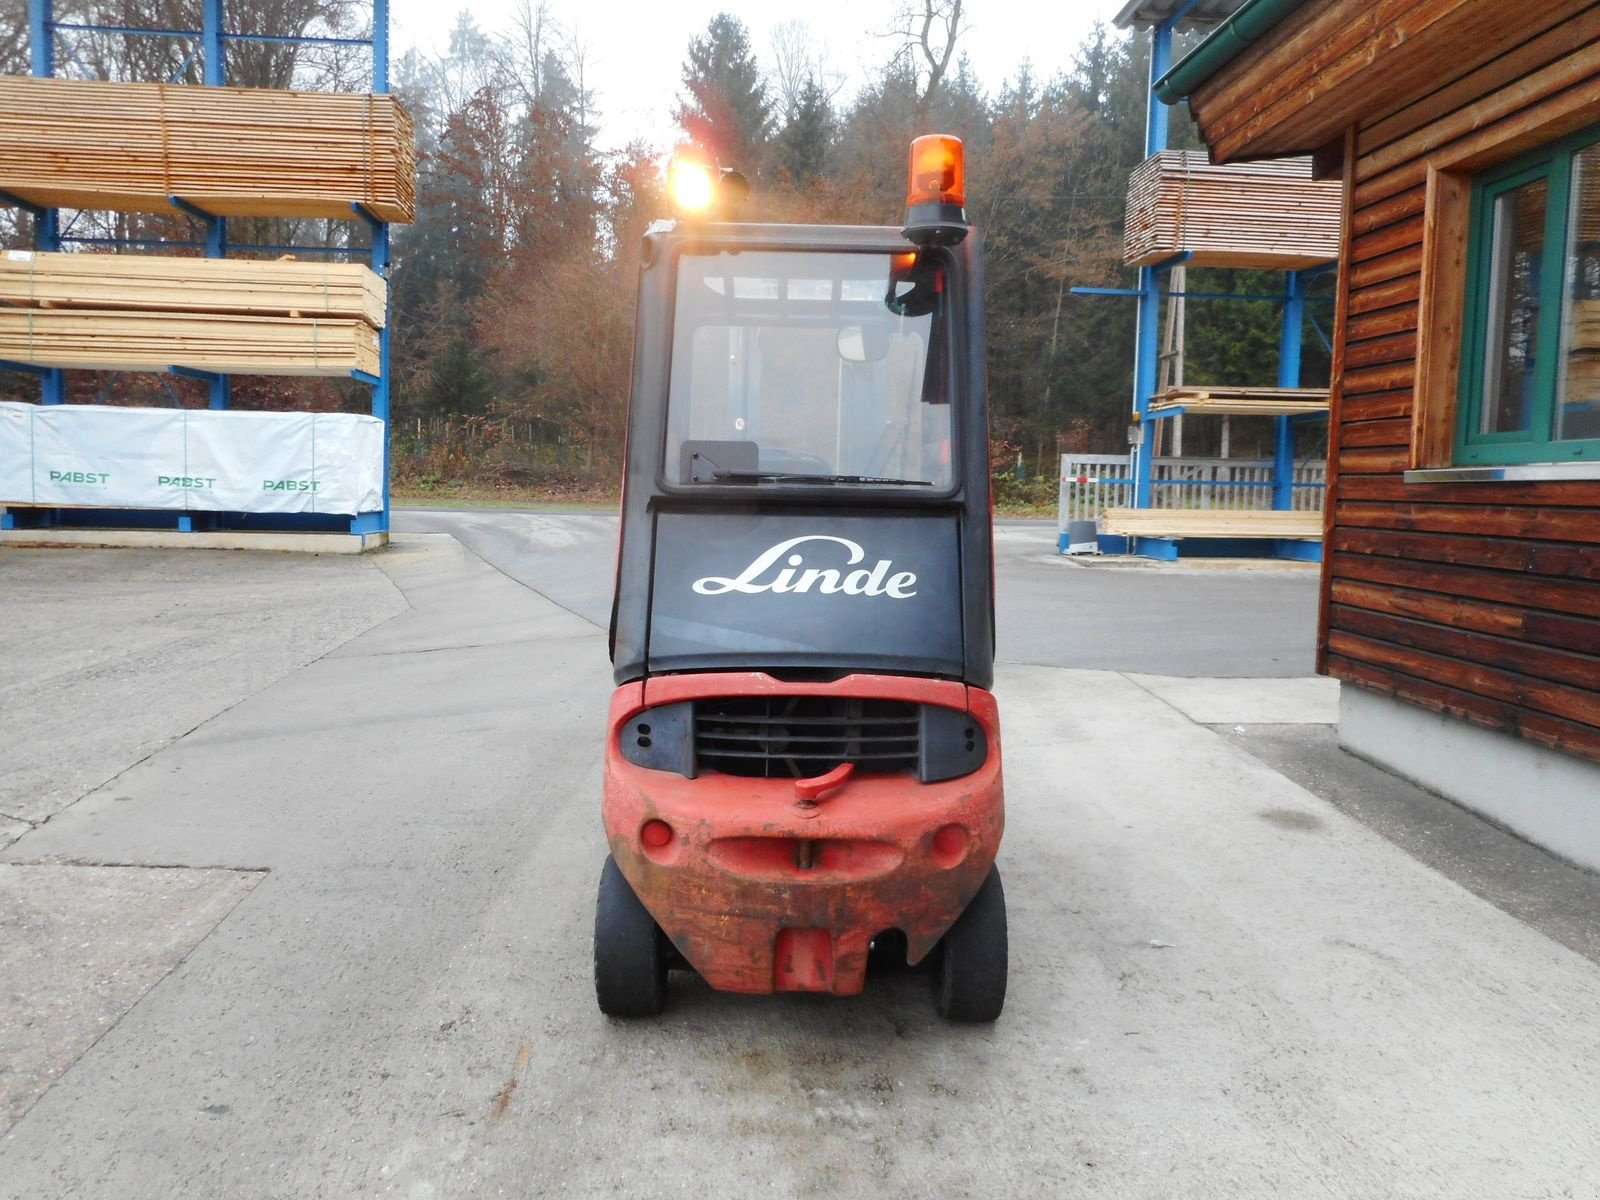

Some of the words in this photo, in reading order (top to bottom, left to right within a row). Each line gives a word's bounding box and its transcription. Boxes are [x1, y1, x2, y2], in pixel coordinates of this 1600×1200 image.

[50, 470, 110, 484] PABST
[158, 475, 217, 489] PABST
[263, 479, 321, 491] PABST
[692, 535, 917, 599] Linde
